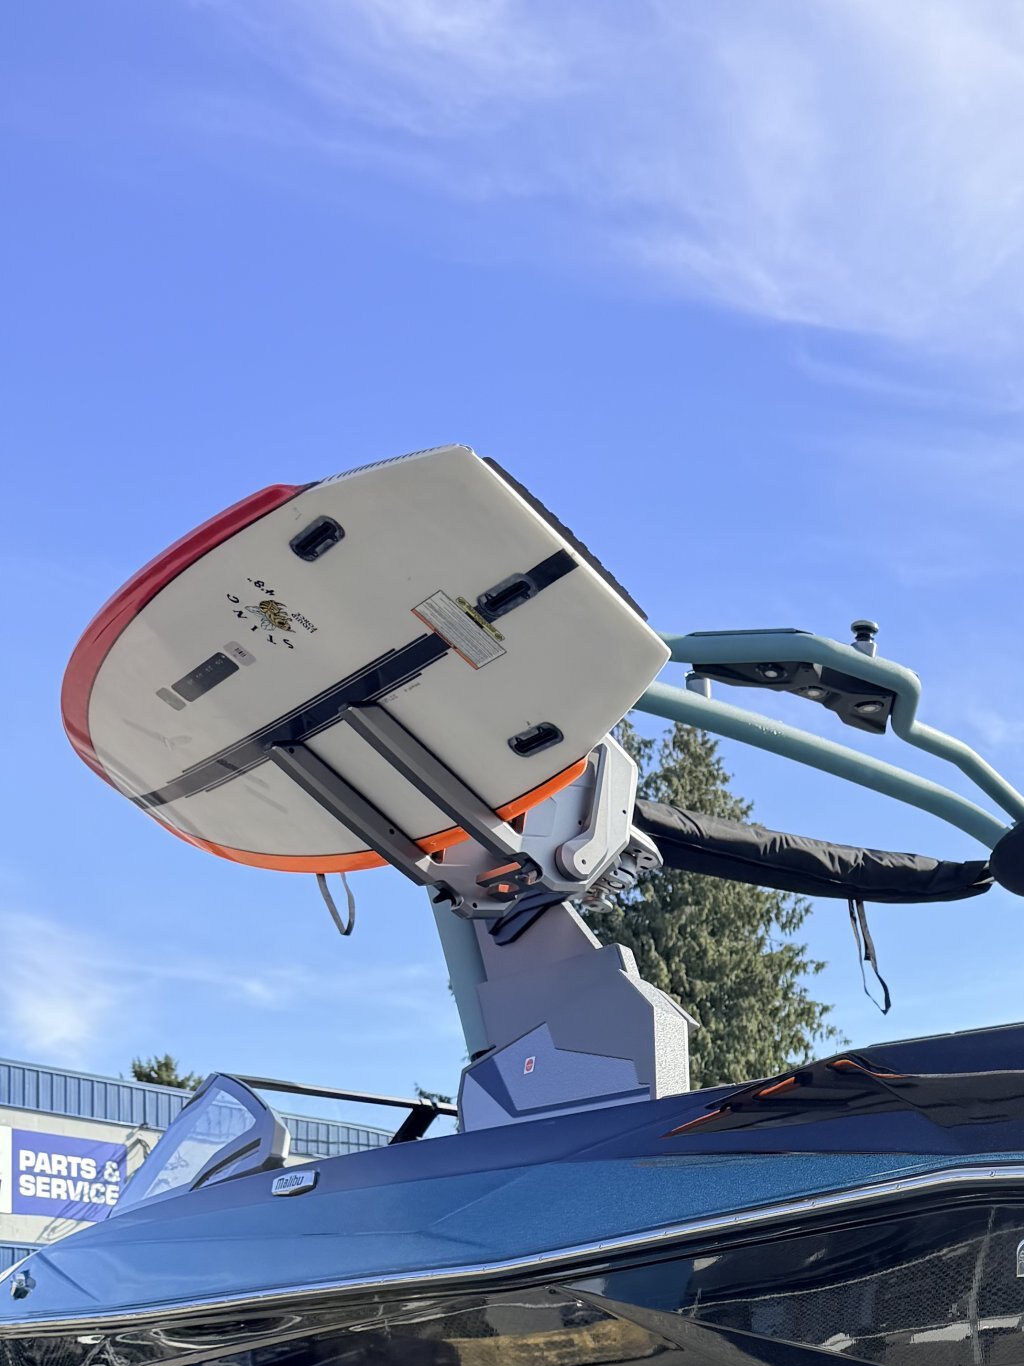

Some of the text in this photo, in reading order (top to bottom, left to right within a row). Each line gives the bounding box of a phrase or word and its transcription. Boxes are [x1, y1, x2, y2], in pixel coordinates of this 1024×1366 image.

[226, 593, 295, 650] STING
[19, 1149, 120, 1182] PARTS &
[19, 1174, 120, 1206] SERVICE
[275, 1174, 304, 1190] Malibu
